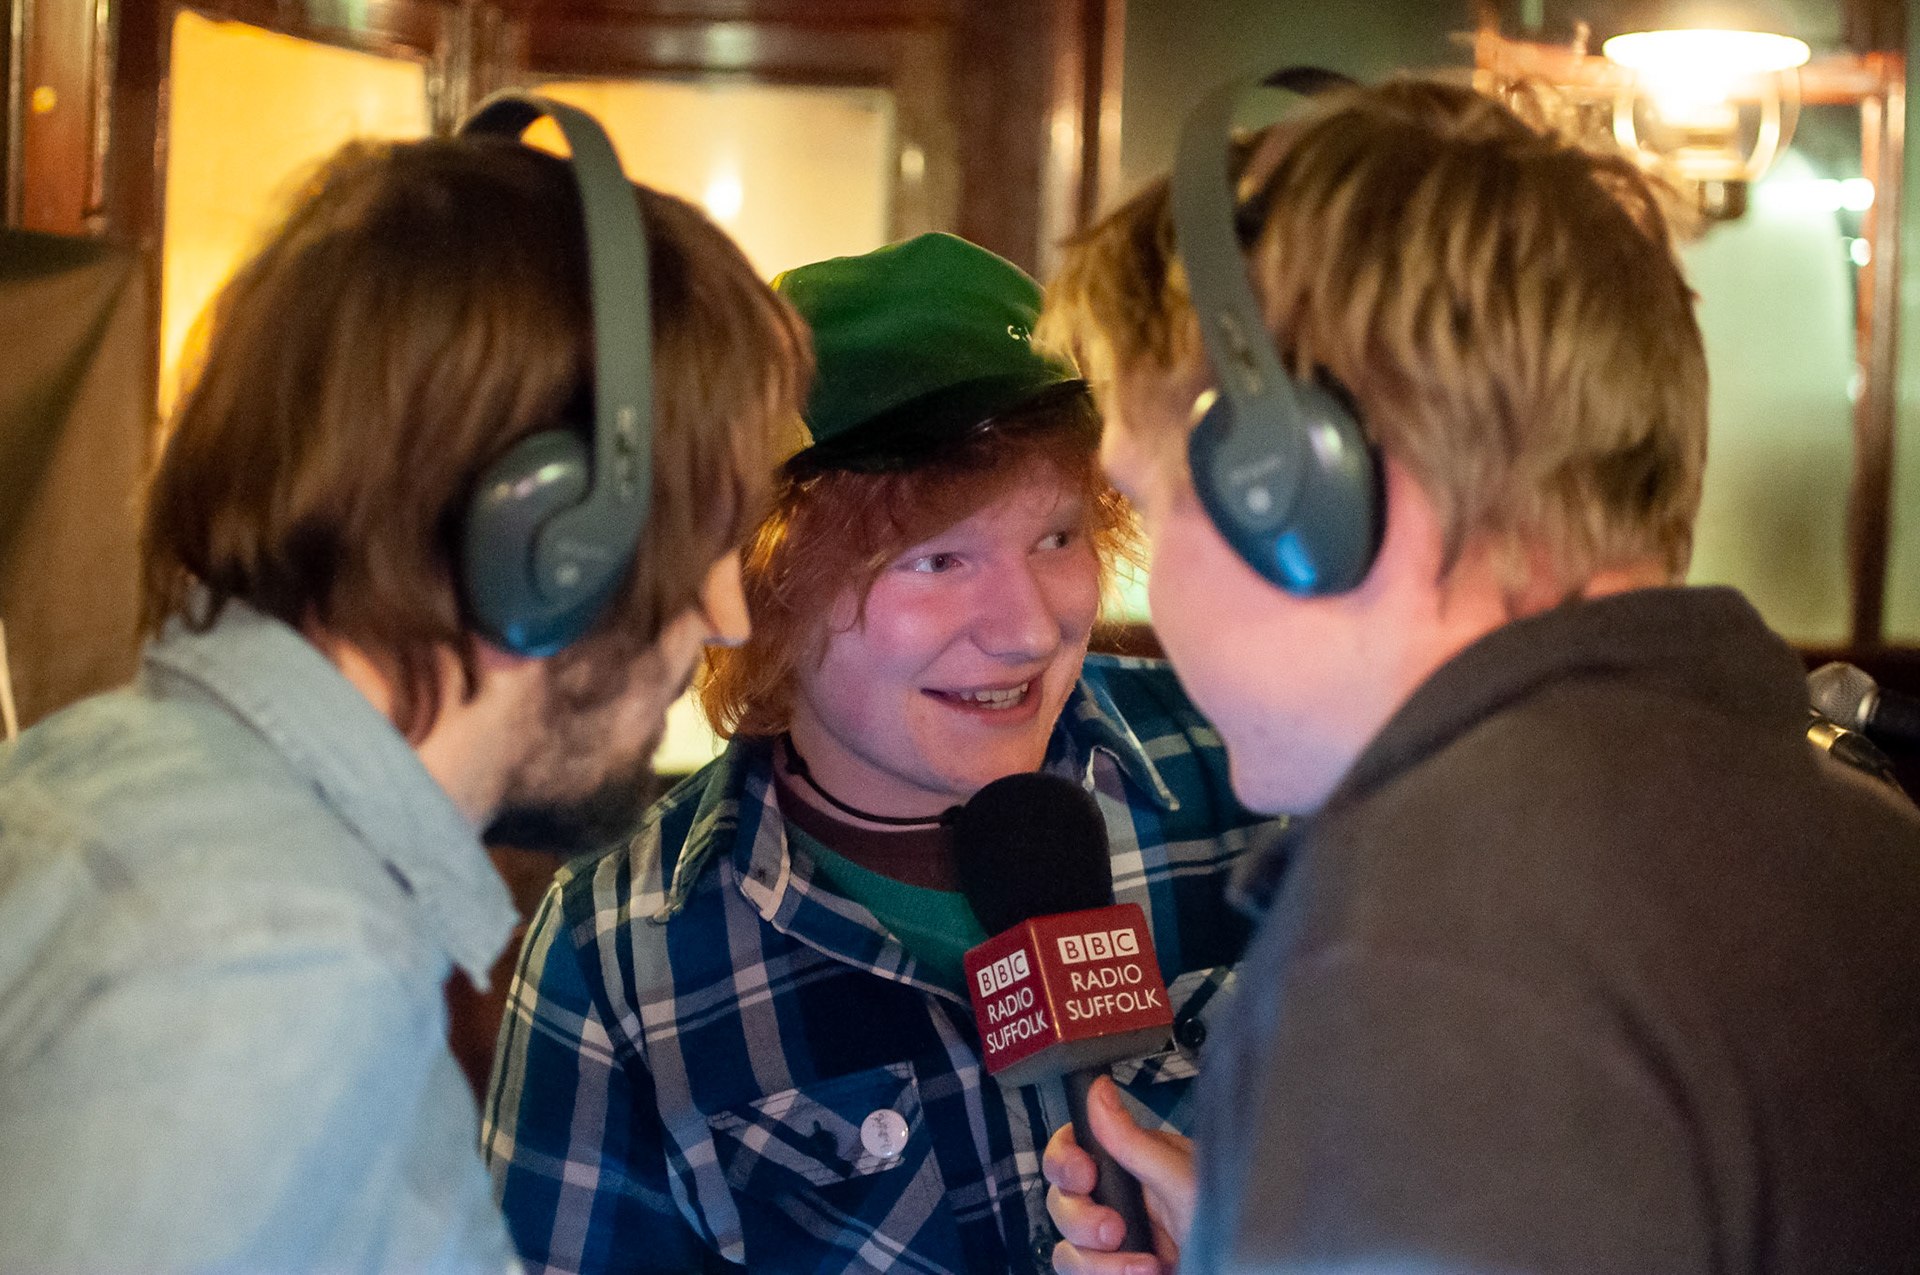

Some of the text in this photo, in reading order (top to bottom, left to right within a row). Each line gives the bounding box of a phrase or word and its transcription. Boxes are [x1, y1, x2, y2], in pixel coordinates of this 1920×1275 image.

[1058, 928, 1138, 964] BBC
[977, 949, 1030, 997] BBC
[1070, 964, 1142, 992] RADIO
[987, 987, 1034, 1024] RADIO
[1065, 988, 1162, 1021] SUFFOLK
[986, 1010, 1049, 1054] SUFFOLK
